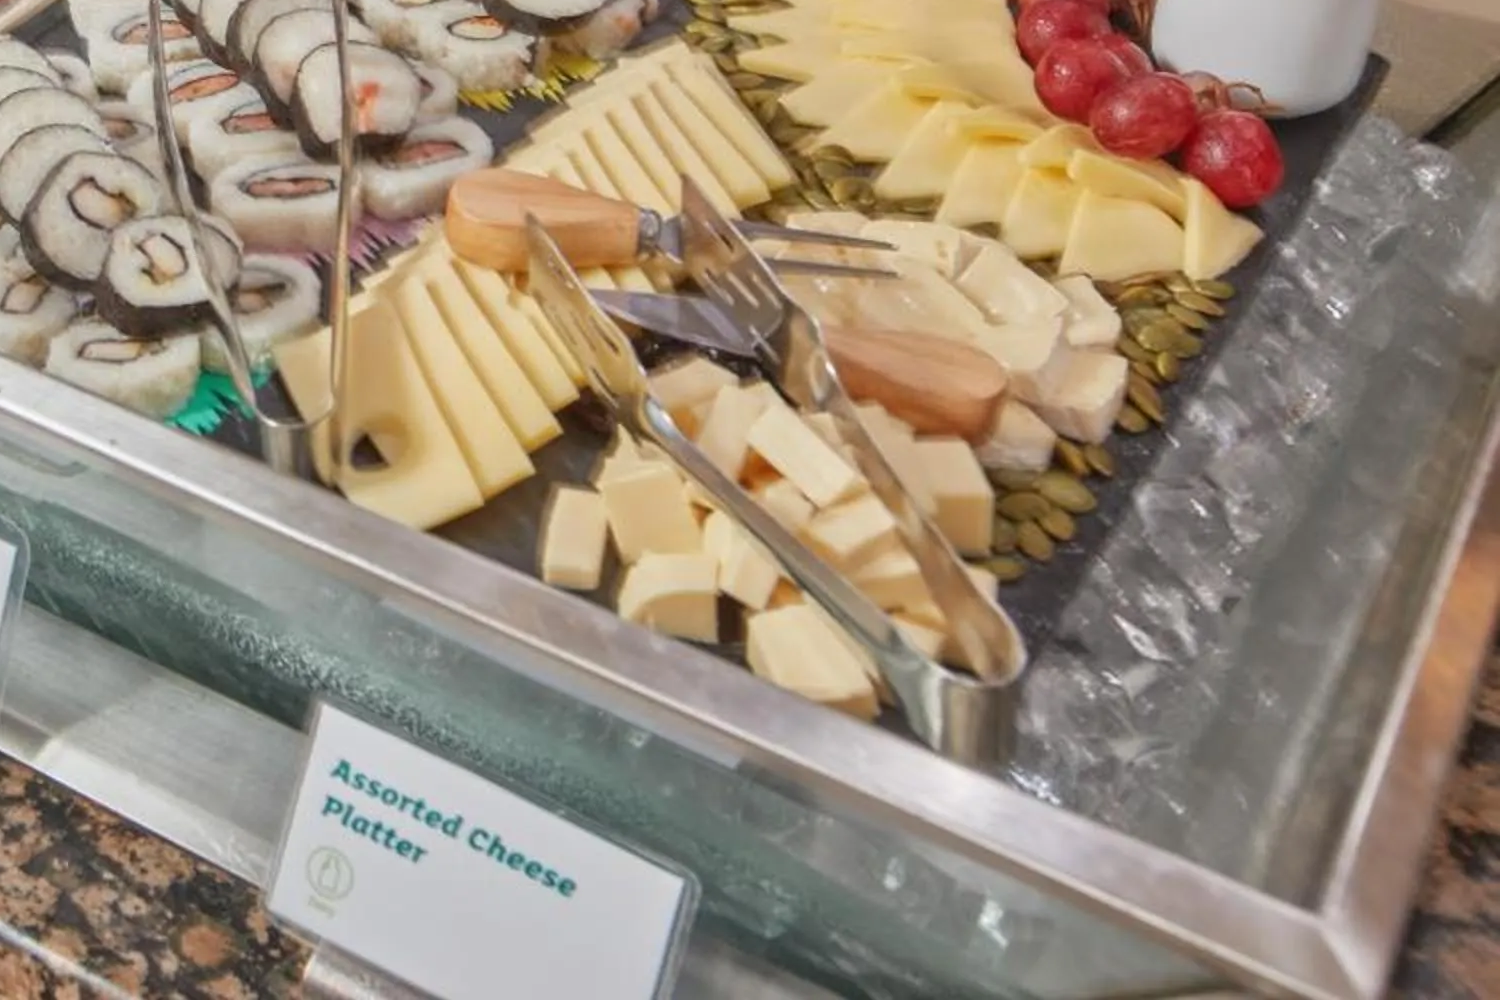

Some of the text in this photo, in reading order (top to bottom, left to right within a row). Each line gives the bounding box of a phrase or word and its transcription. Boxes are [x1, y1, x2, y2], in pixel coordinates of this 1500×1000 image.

[321, 795, 429, 866] Platter
[330, 758, 578, 899] Assorted Cheese
